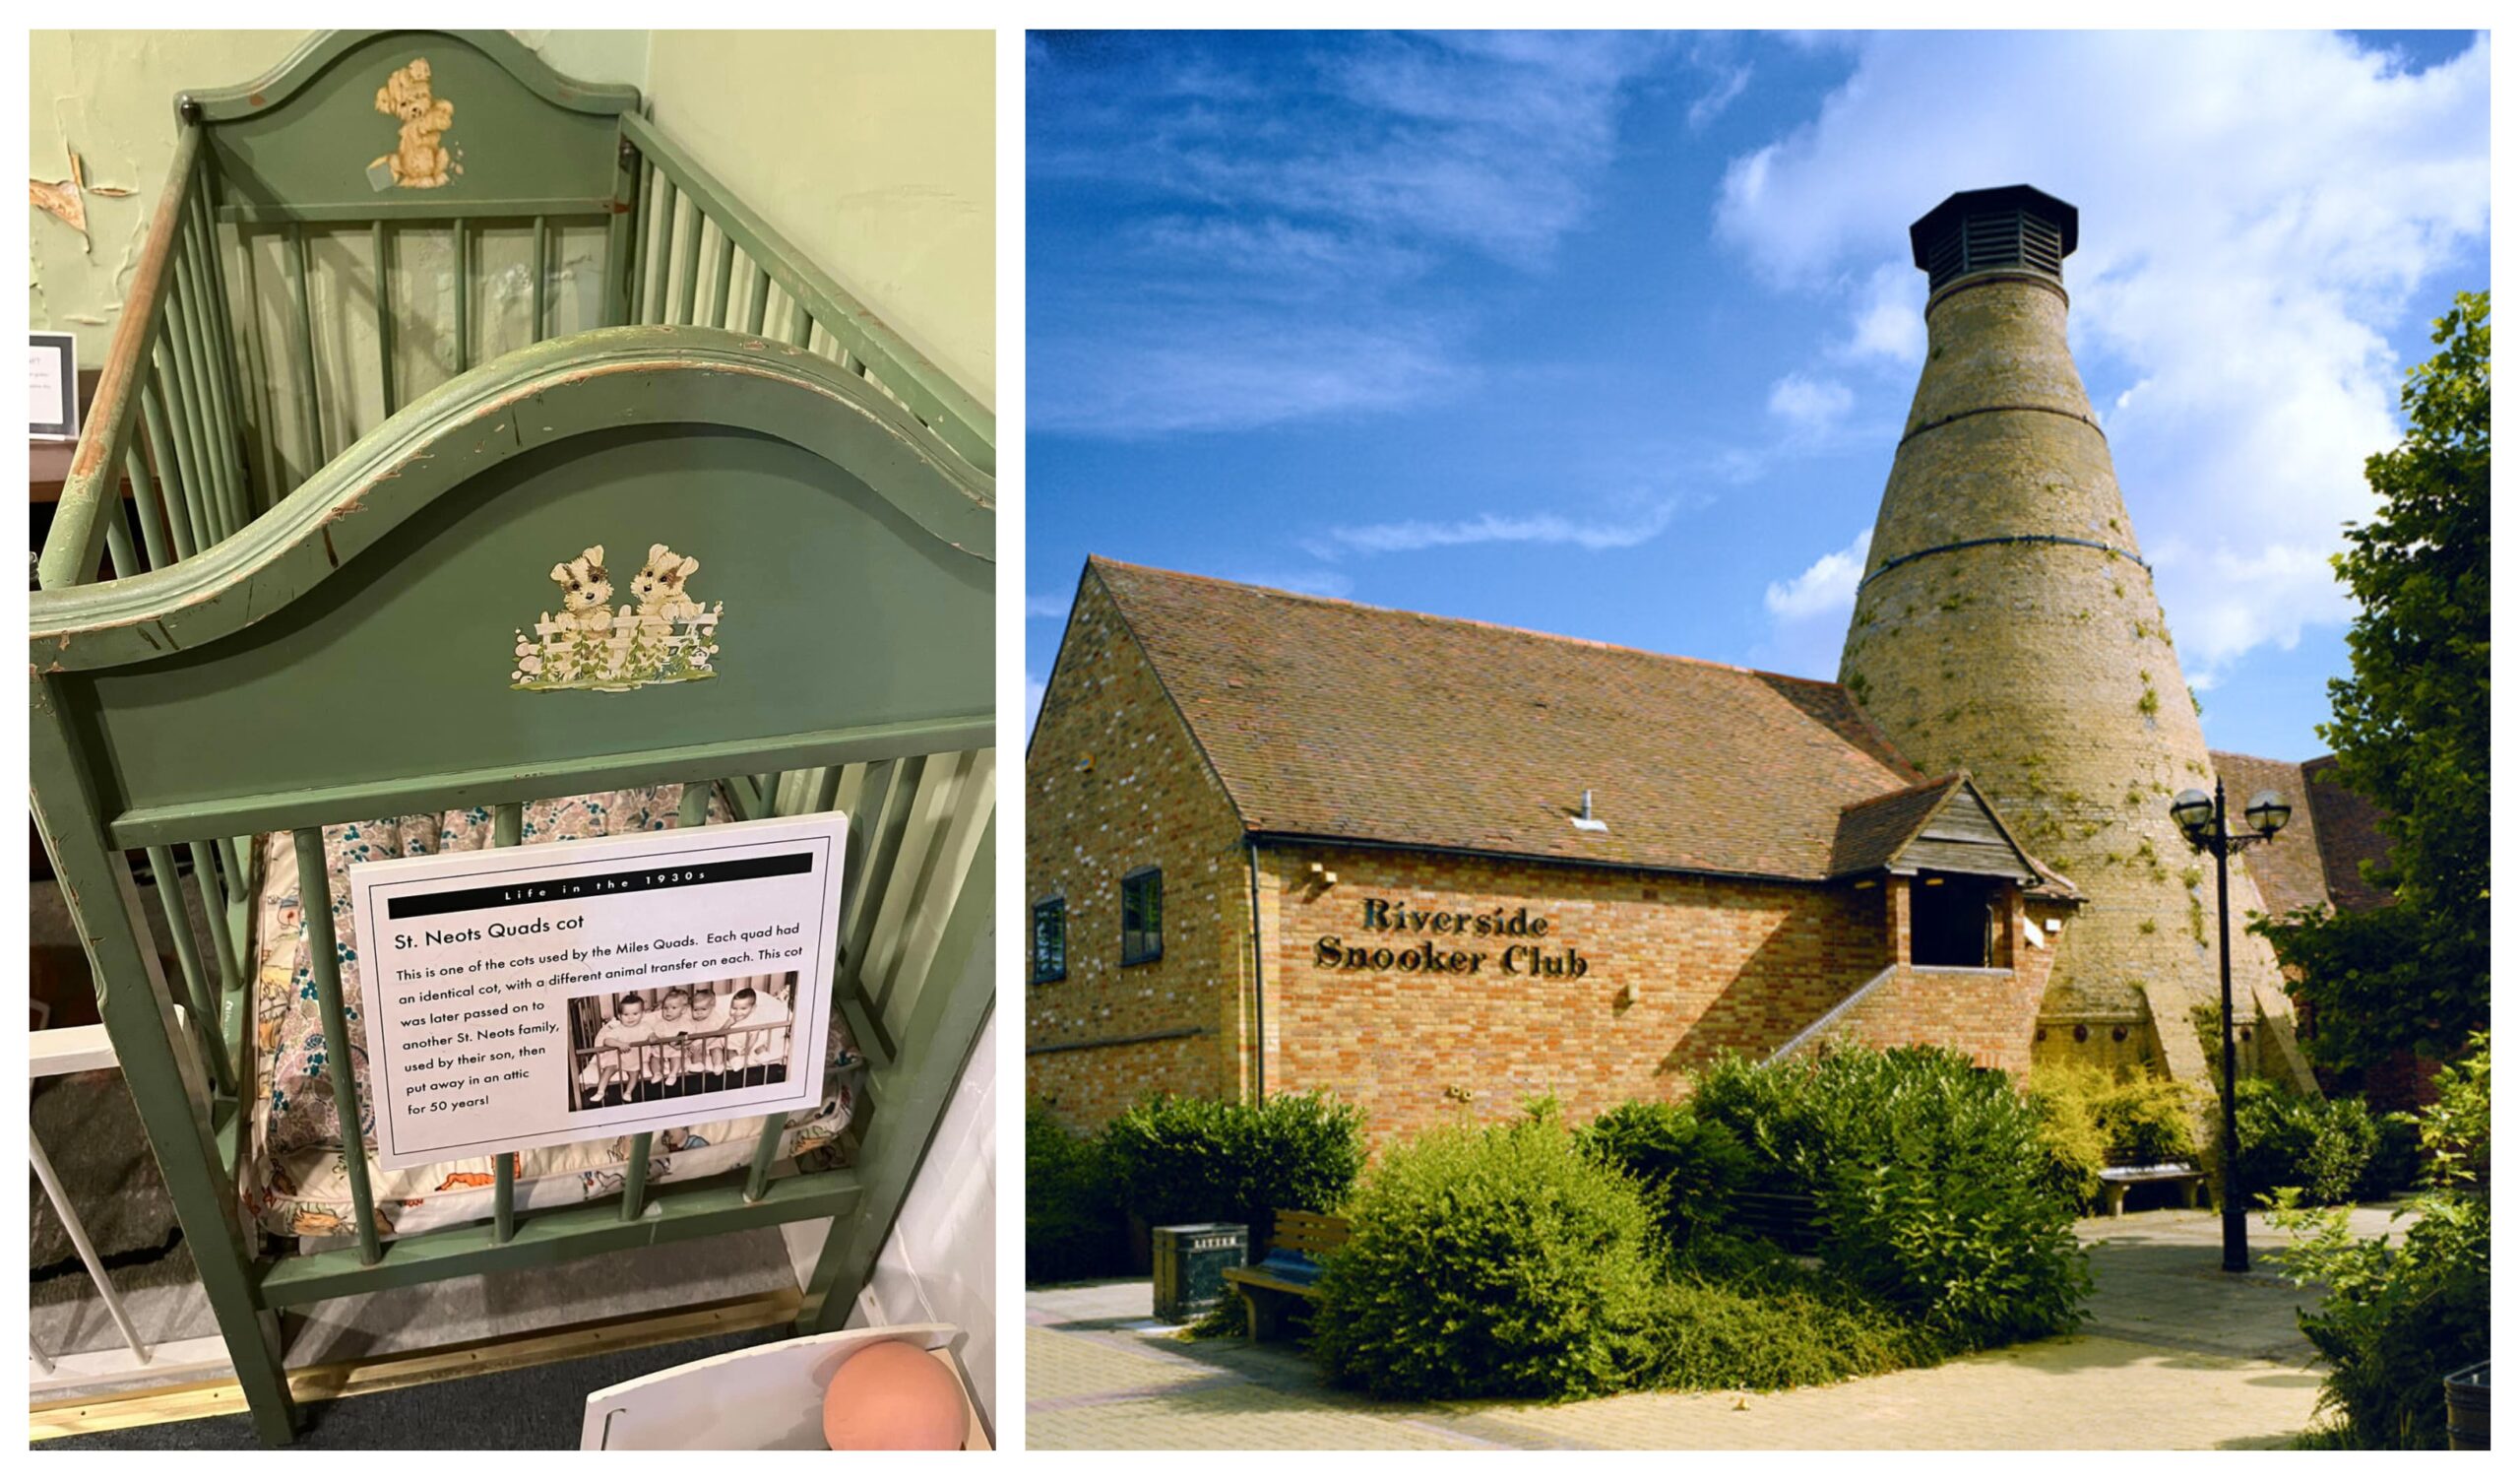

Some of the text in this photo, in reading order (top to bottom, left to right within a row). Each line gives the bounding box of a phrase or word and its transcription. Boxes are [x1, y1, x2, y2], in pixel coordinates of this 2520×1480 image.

[505, 871, 705, 901] Life in the 1930s
[394, 914, 585, 950] St. Neots Quads cot
[1362, 897, 1548, 936] Riverside
[395, 922, 799, 982] This is one of the cots used by the Miles Quads. Each quad had
[1315, 934, 1588, 978] Snooker Club
[398, 945, 803, 1005] an identical cot, with a different animal transfer on each. This cot
[400, 1000, 545, 1028] was later passed on to
[402, 1020, 560, 1051] another St. Neots family,
[404, 1045, 545, 1072] used by their son, then
[406, 1068, 530, 1097] put away in an attic
[407, 1094, 489, 1116] for 50 years!
